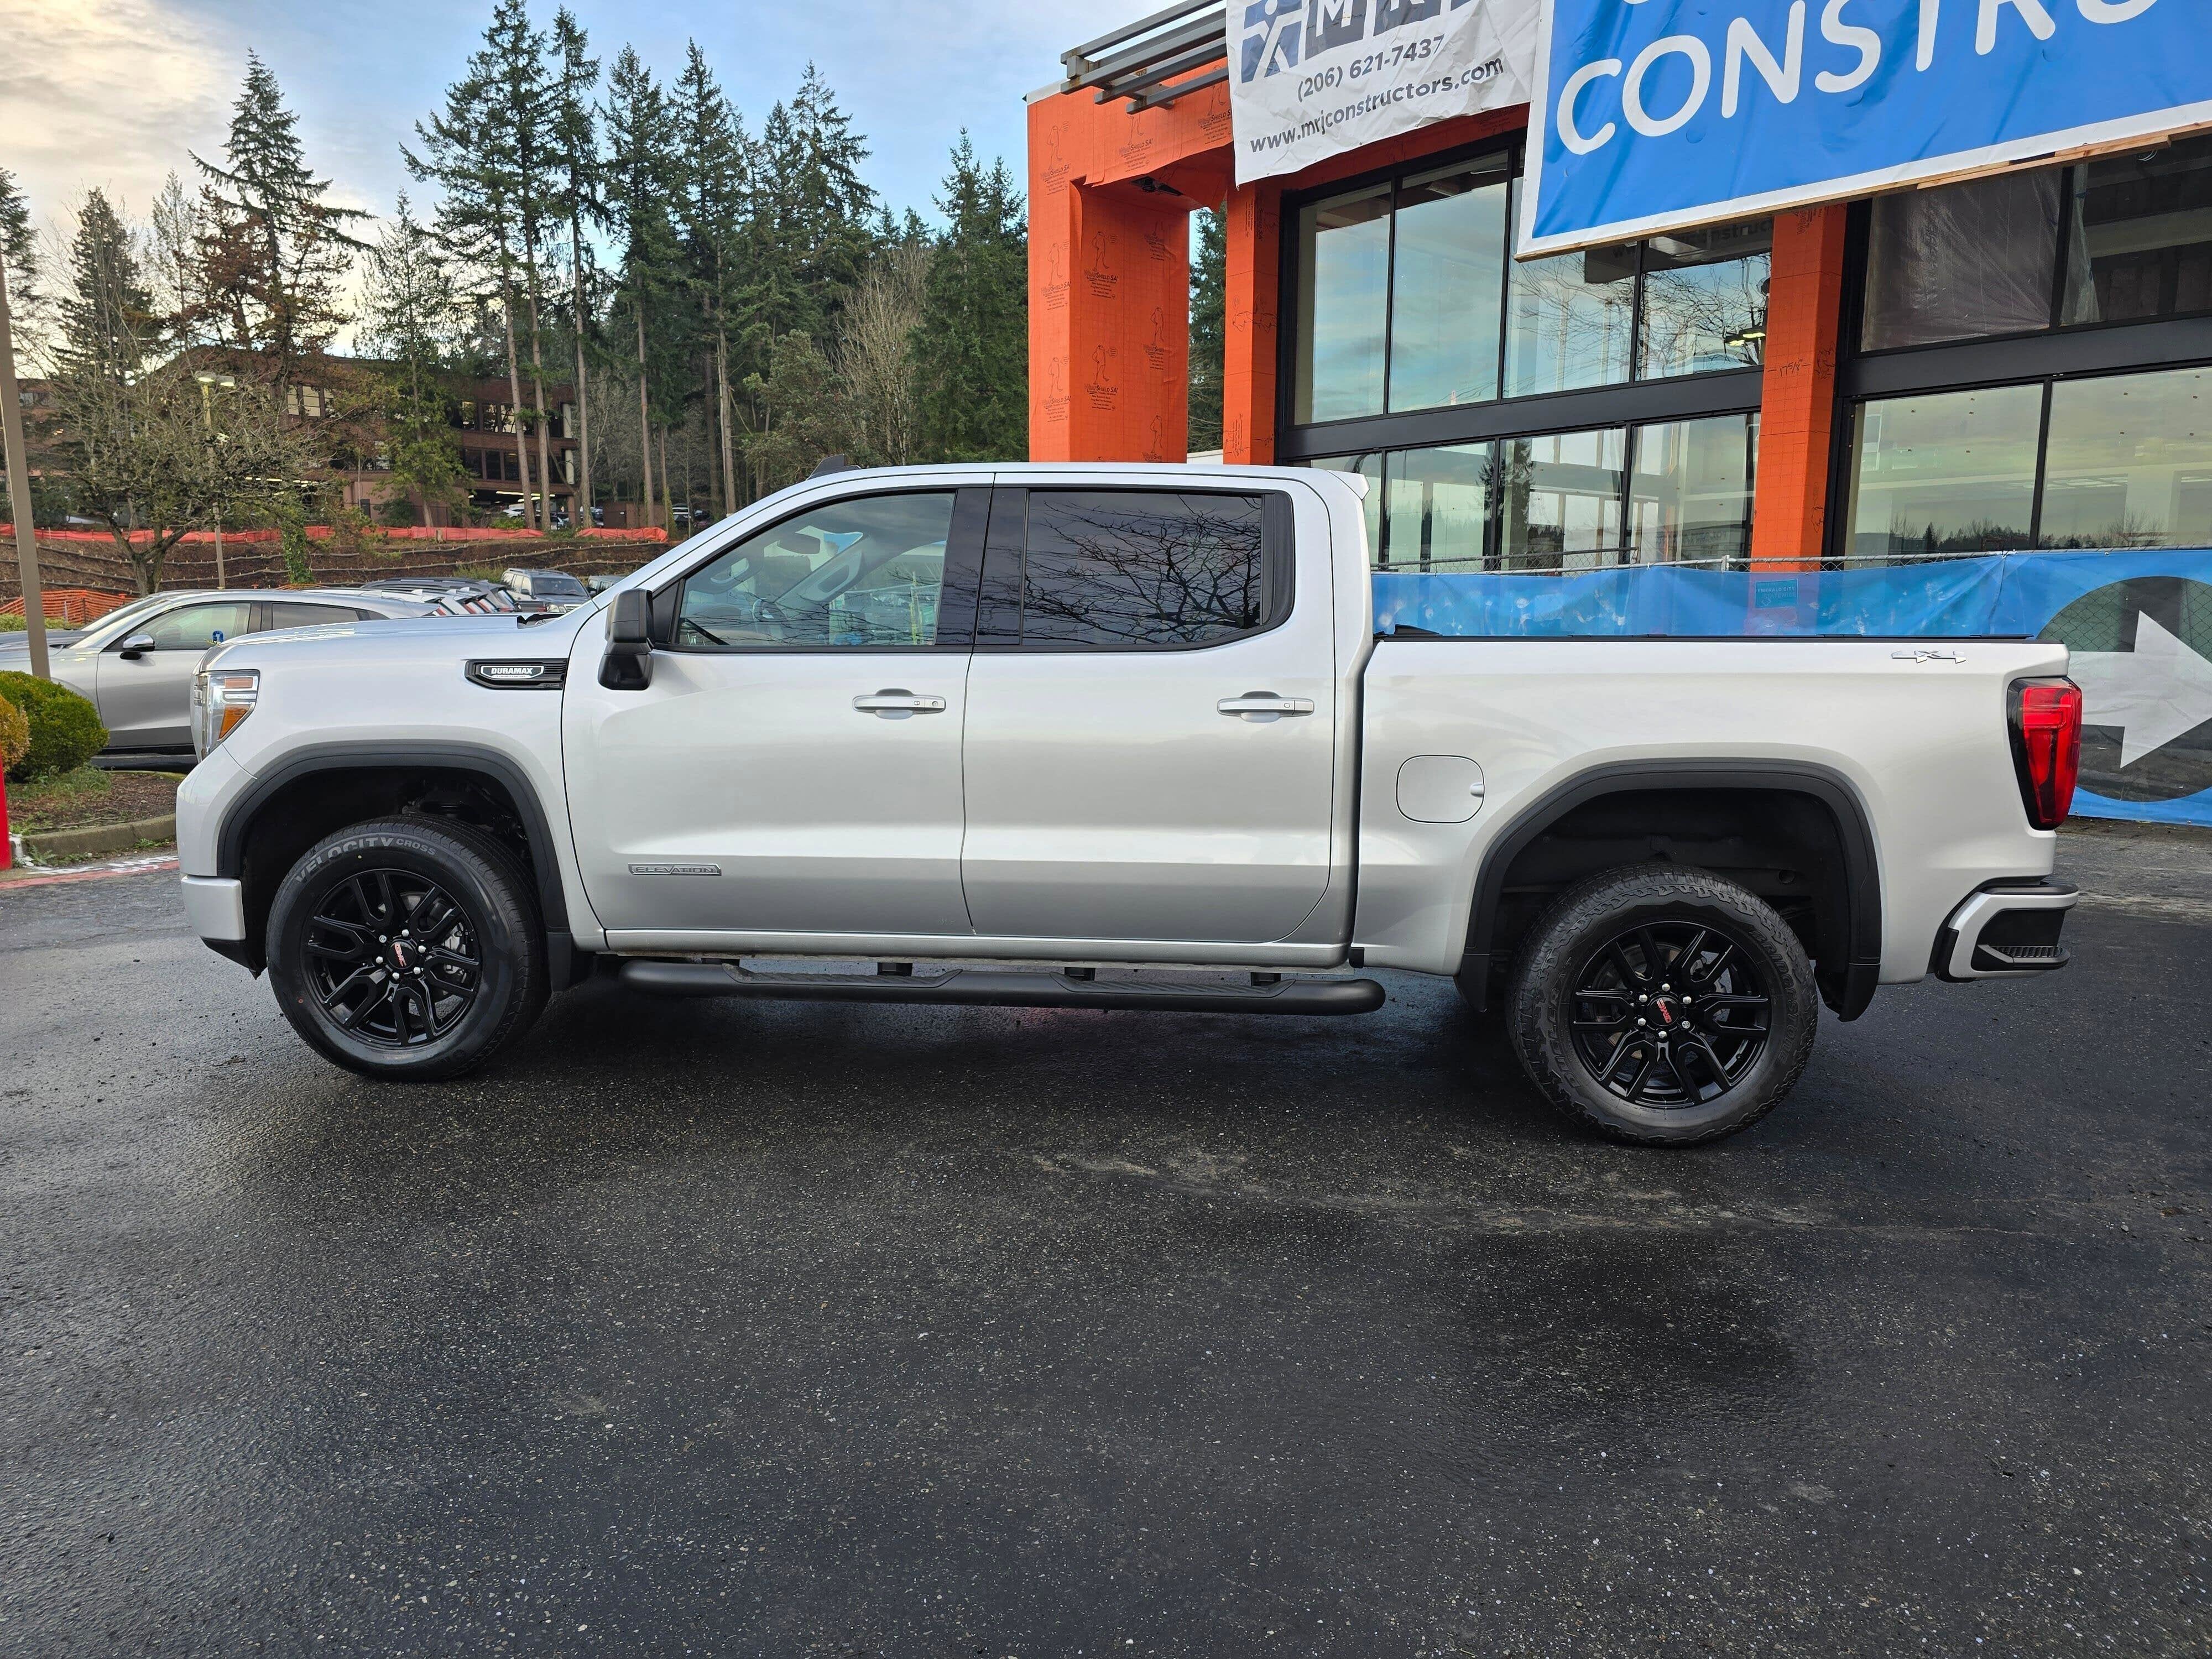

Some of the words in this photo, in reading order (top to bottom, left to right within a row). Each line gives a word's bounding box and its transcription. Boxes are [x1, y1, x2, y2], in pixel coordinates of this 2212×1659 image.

[1298, 69, 1343, 102] (206)
[1349, 34, 1445, 79] 621-7437
[1250, 56, 1504, 153] www.mrjconstructors.com
[396, 838, 436, 855] CROSS
[635, 865, 714, 874] ELEVATION
[394, 943, 407, 967] GMC
[1657, 999, 1672, 1023] GMC
